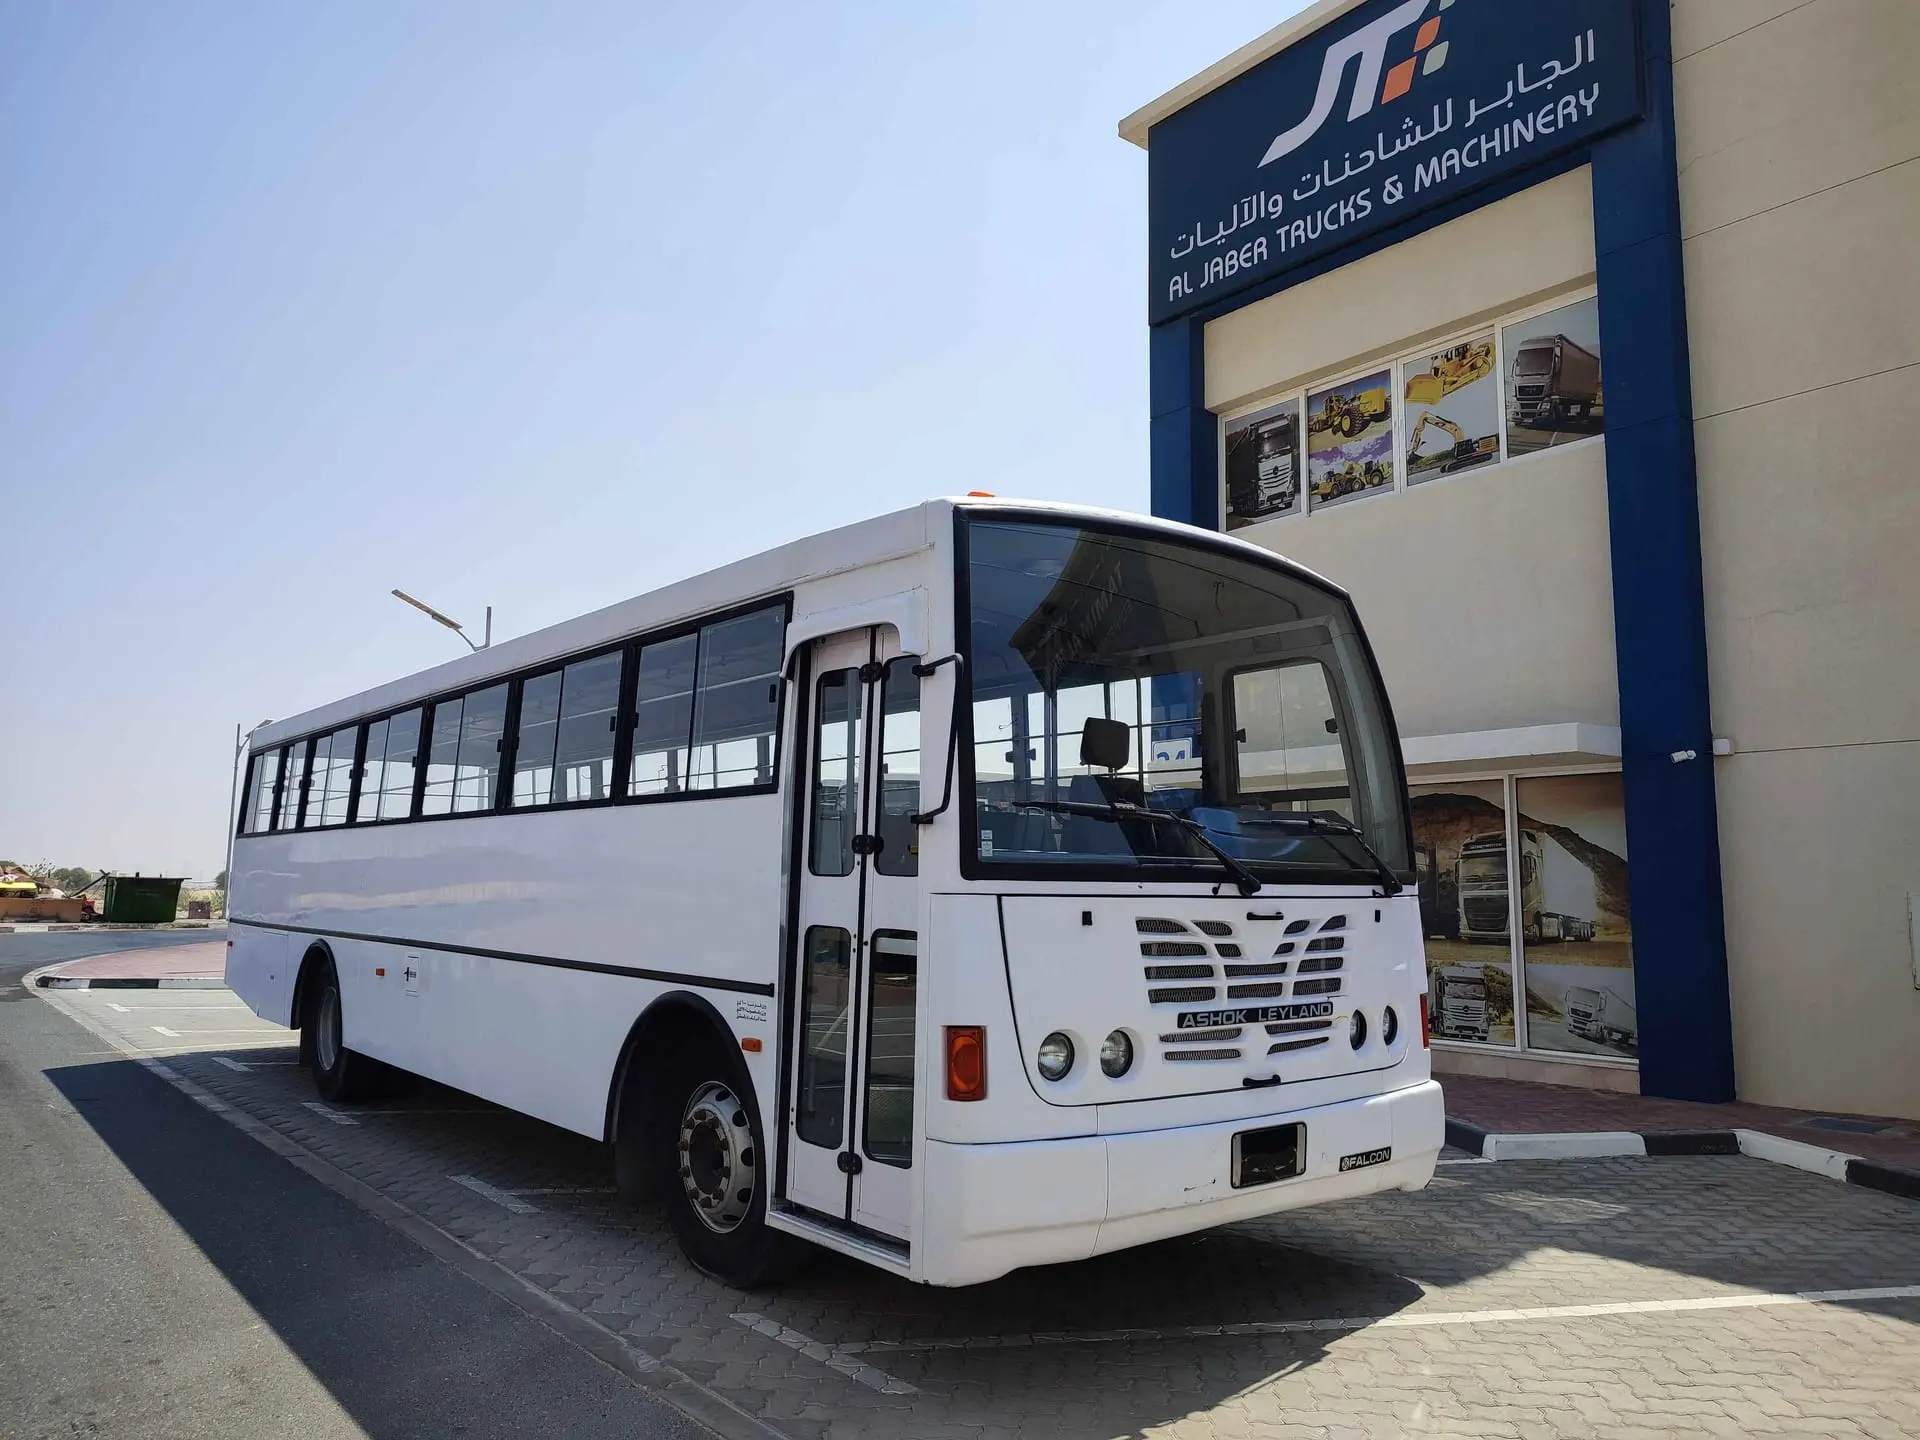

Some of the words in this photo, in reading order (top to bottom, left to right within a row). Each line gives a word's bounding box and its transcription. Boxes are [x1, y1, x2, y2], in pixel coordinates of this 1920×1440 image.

[1465, 29, 1595, 128] الجابر
[1170, 272, 1193, 302] AL
[1200, 236, 1268, 289] JABER
[1277, 187, 1372, 253] TRUCKS
[1383, 175, 1405, 205] &
[1414, 83, 1599, 193] MACHINERY
[1293, 98, 1453, 201] للشاحنات
[1182, 1010, 1247, 1028] ASHOK
[1258, 1003, 1332, 1022] LEYLAND
[1349, 1149, 1390, 1168] FALCON
